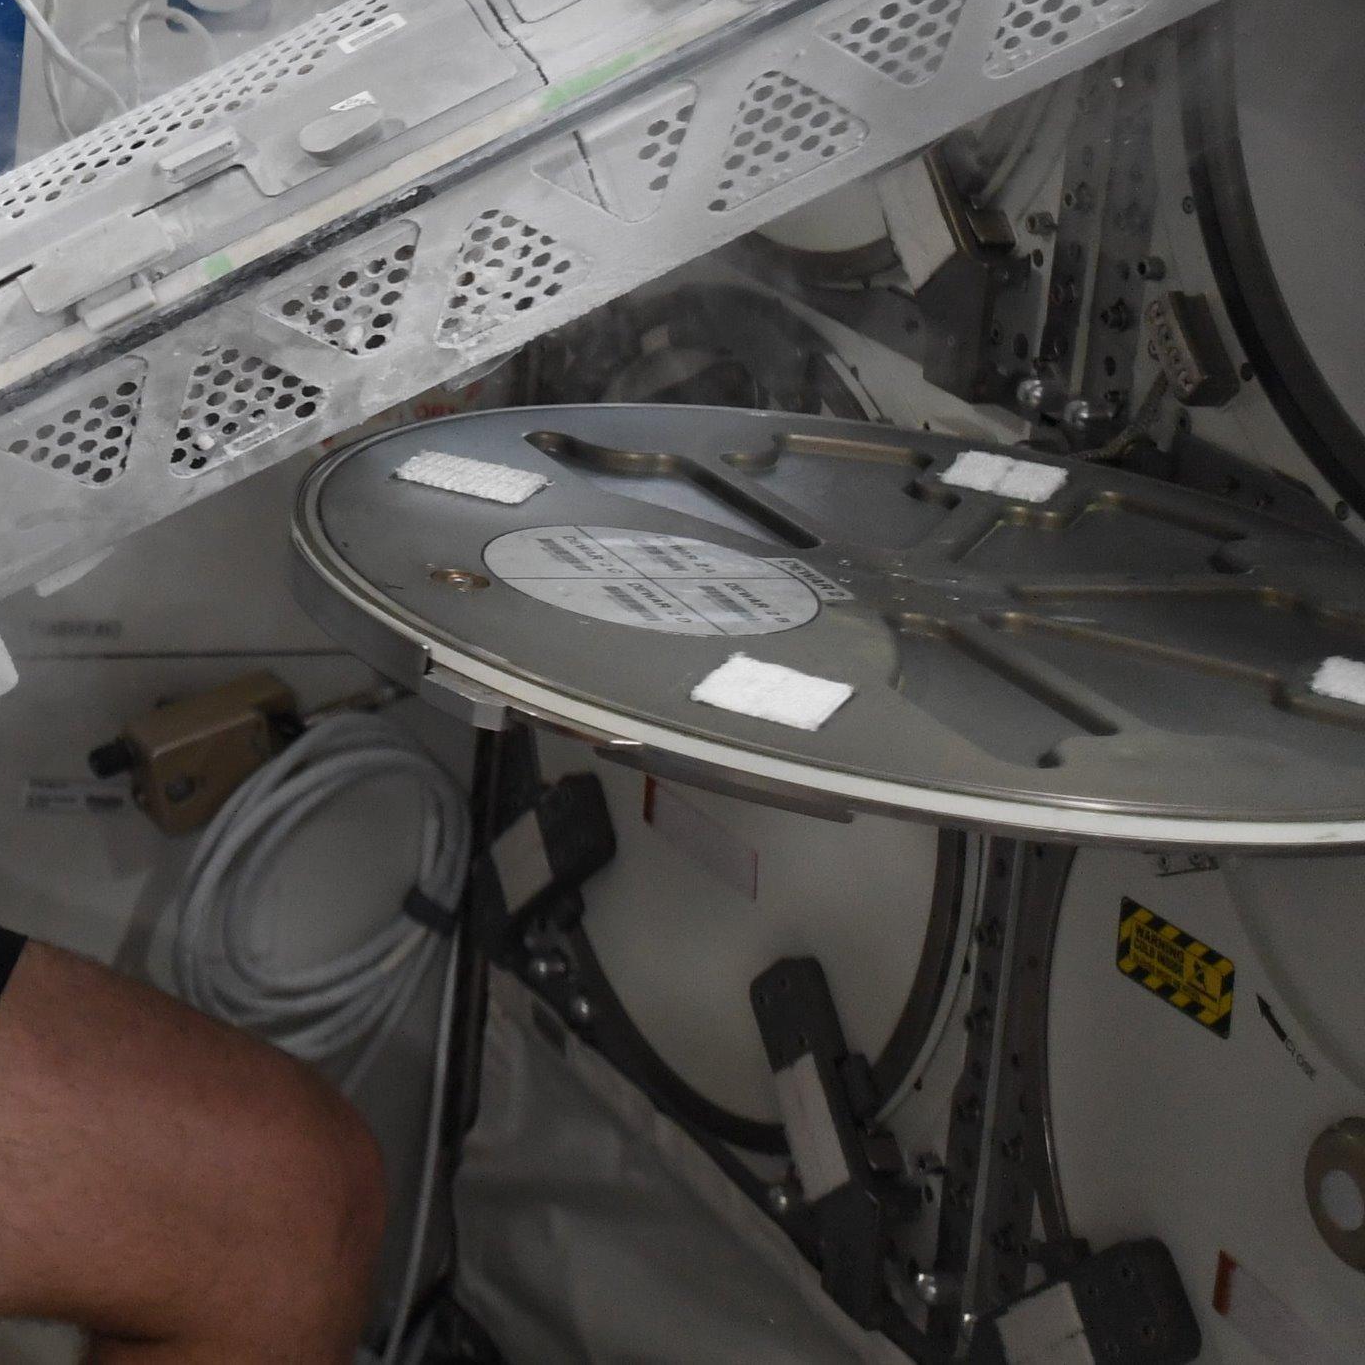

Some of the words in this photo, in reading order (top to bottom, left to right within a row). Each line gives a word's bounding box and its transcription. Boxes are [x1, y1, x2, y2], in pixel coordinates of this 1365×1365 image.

[562, 535, 604, 560] DEWAR
[779, 559, 836, 591] DEWAR
[627, 582, 673, 609] DEWAR
[724, 582, 771, 609] DEWAR
